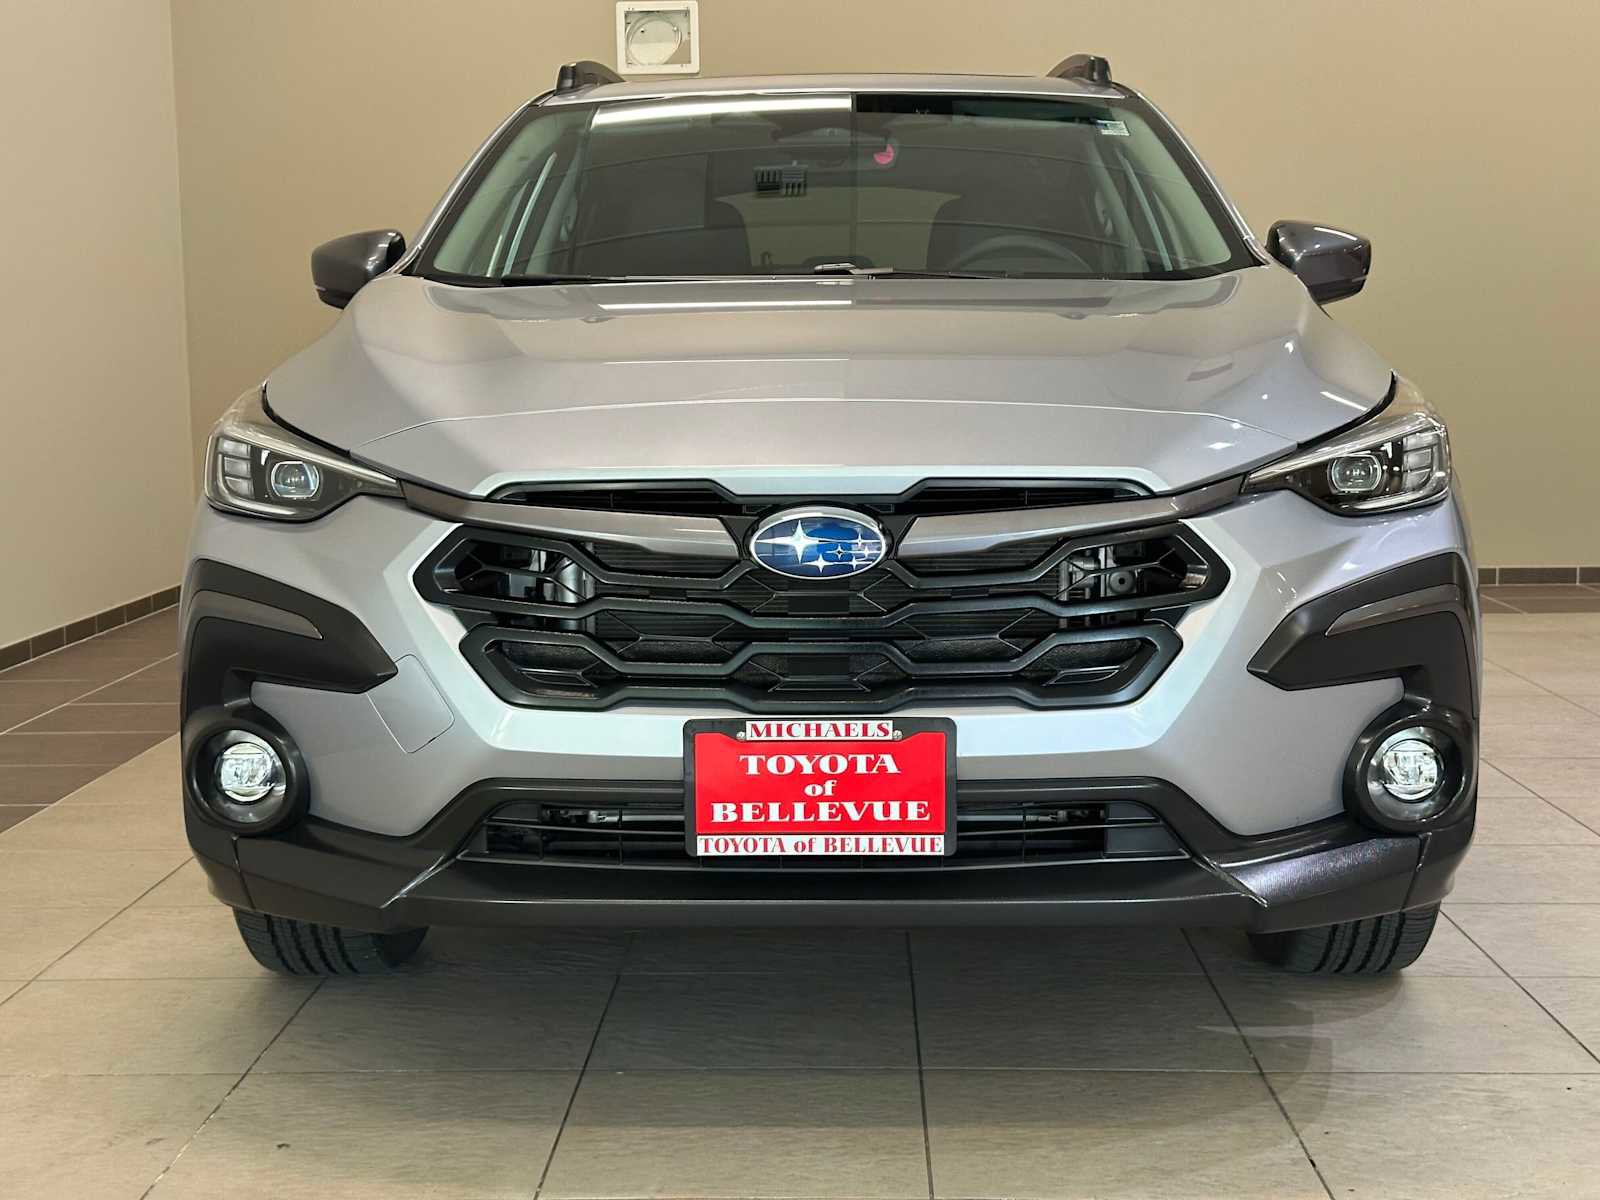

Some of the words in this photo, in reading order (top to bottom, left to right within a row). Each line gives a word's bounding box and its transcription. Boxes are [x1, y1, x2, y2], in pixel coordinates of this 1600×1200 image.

[750, 723, 890, 737] MICHAELS
[740, 754, 901, 775] TOYOTA
[805, 780, 837, 796] of
[711, 801, 931, 822] BELLEVUE
[700, 838, 786, 853] TOYOTA
[794, 838, 816, 853] of
[824, 837, 942, 853] BELLEVUE
